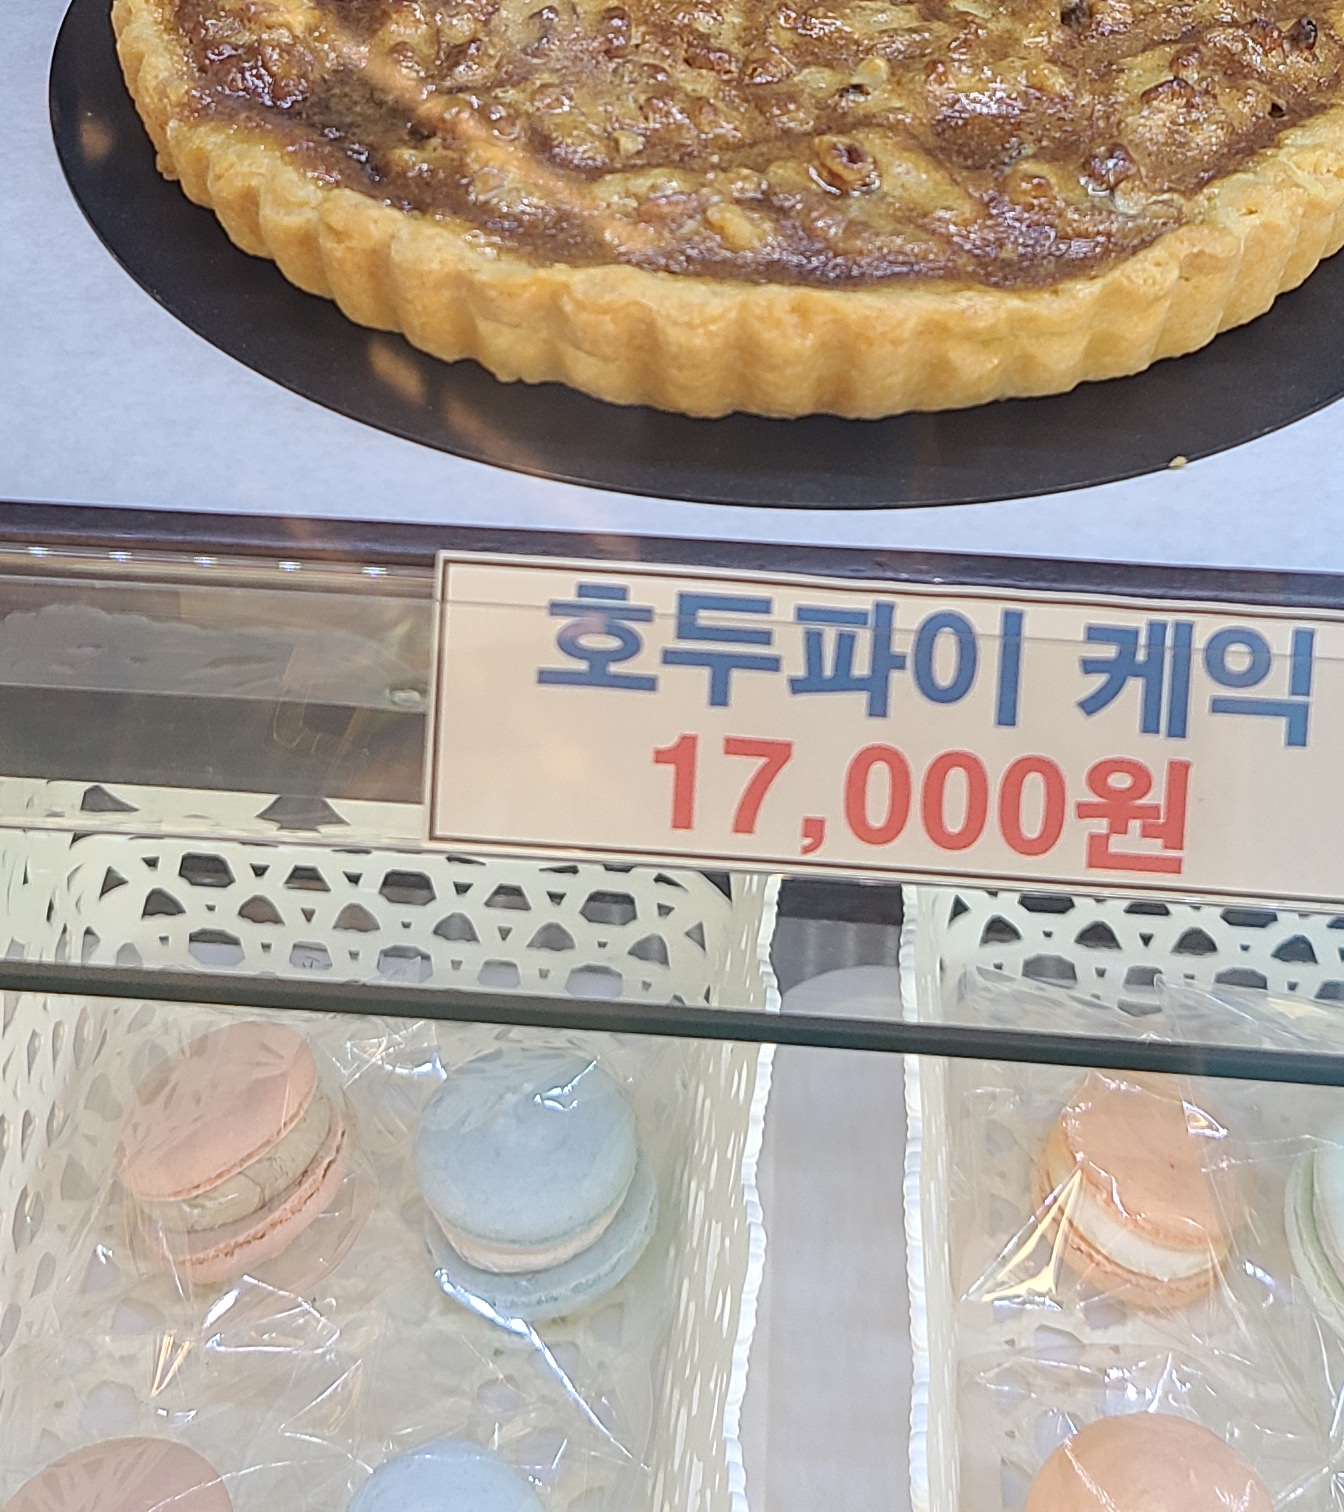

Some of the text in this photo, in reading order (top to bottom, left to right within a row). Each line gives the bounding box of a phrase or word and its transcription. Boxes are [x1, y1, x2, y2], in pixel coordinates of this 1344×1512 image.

[536, 583, 1317, 749] 호두파이 케익
[653, 733, 1192, 876] 17,000원
